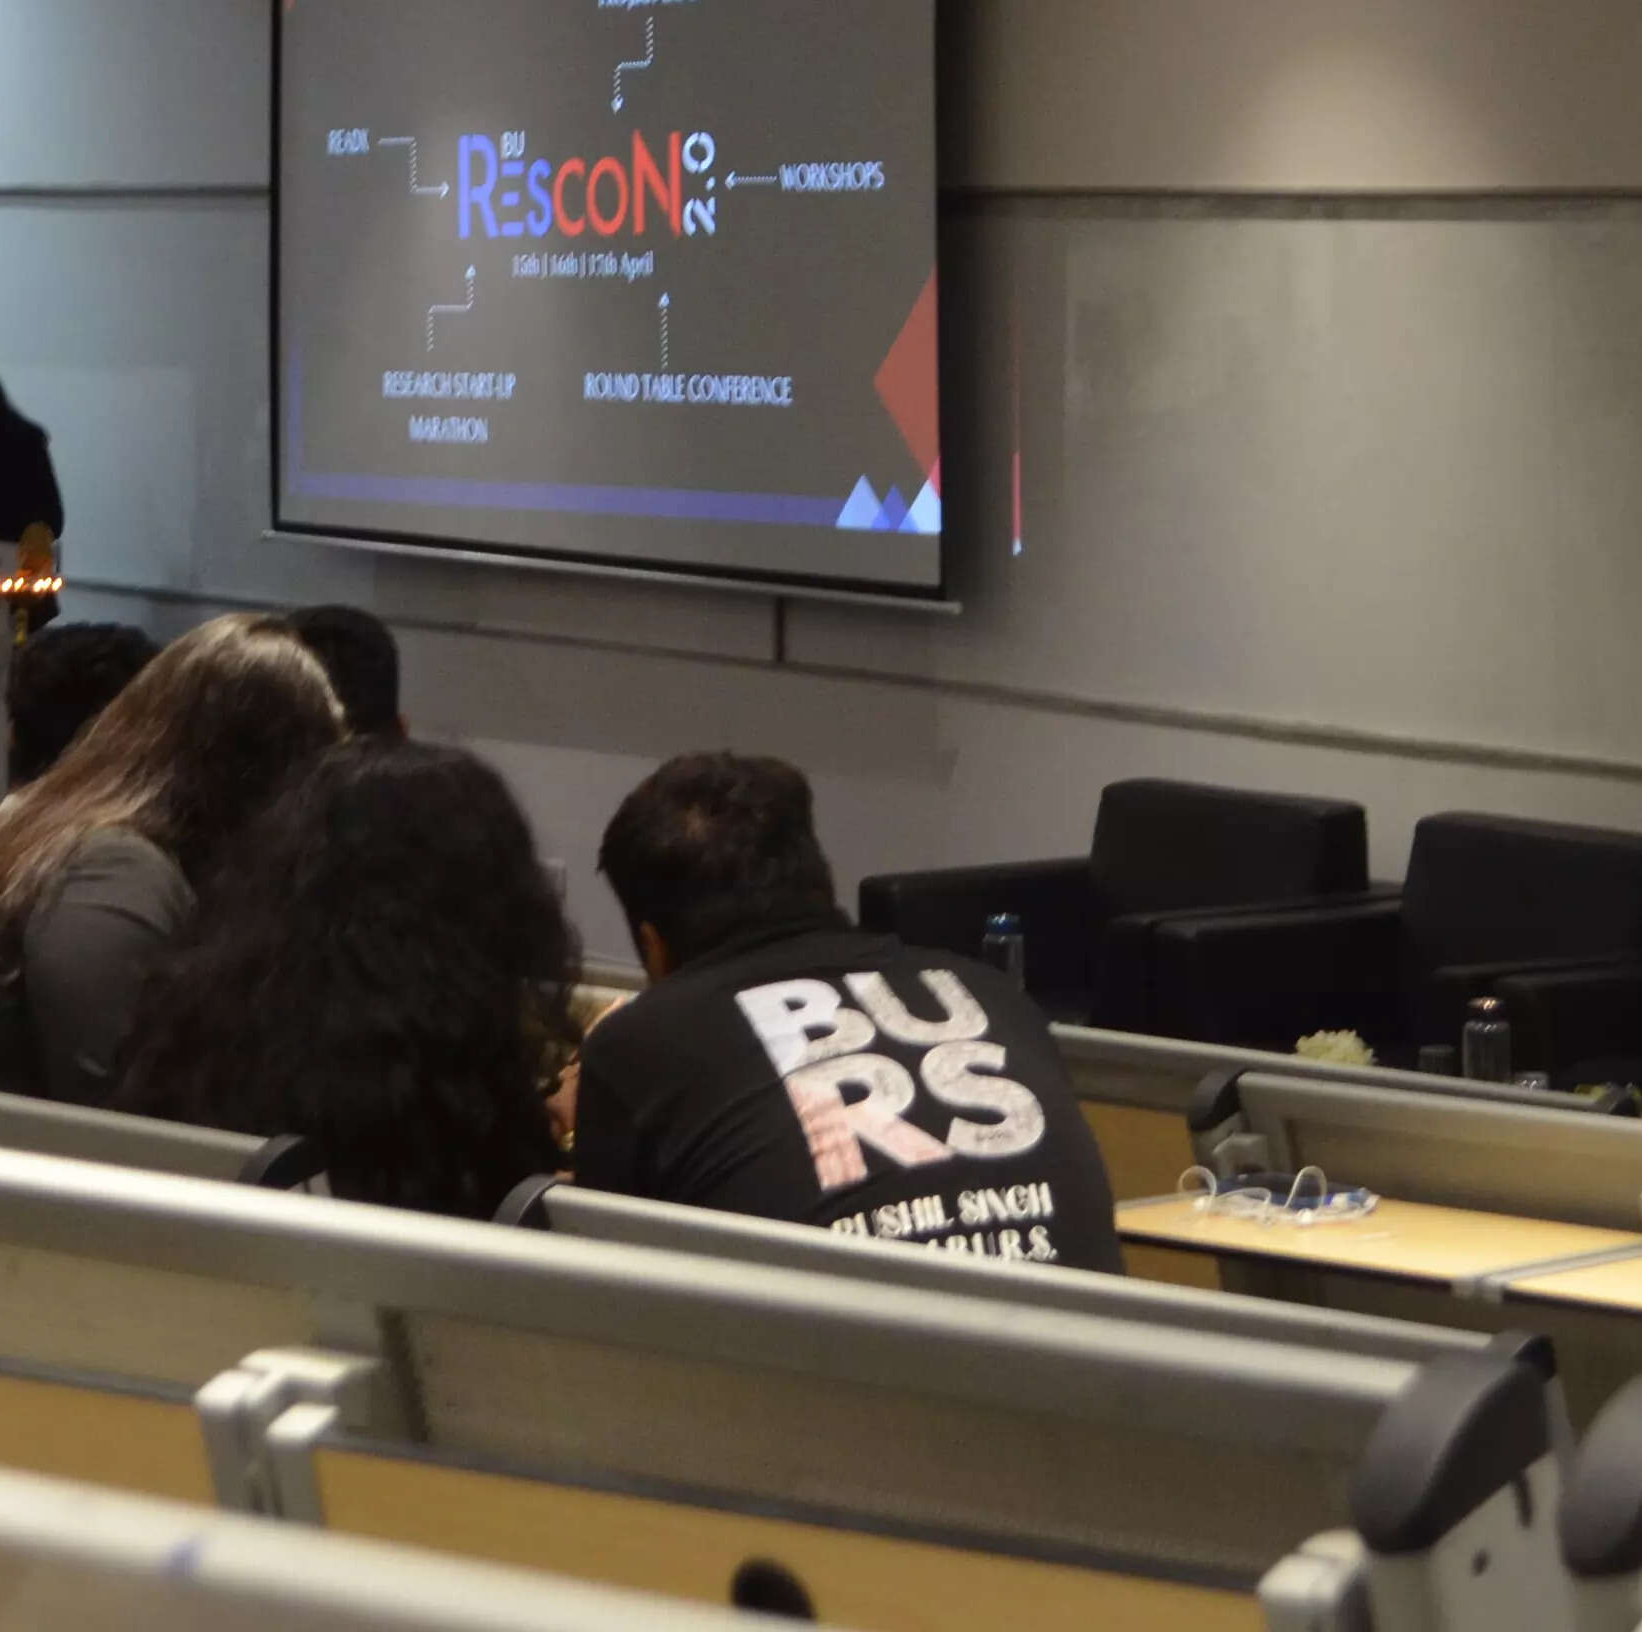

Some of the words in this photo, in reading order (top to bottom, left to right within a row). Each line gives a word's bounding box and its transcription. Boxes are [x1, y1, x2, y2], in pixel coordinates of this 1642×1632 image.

[327, 129, 370, 156] READX
[500, 130, 525, 160] BU
[779, 161, 885, 192] WORKSHOPS
[512, 252, 540, 278] 15th
[551, 253, 578, 278] 16th
[589, 253, 617, 278] 17th
[618, 251, 654, 282] April
[382, 371, 455, 398] RESEARCH
[456, 371, 516, 399] START-UP
[583, 372, 639, 402] ROUND
[641, 374, 686, 403] TABLE
[687, 375, 793, 407] CONFERENCE
[408, 415, 489, 443] MARATHON
